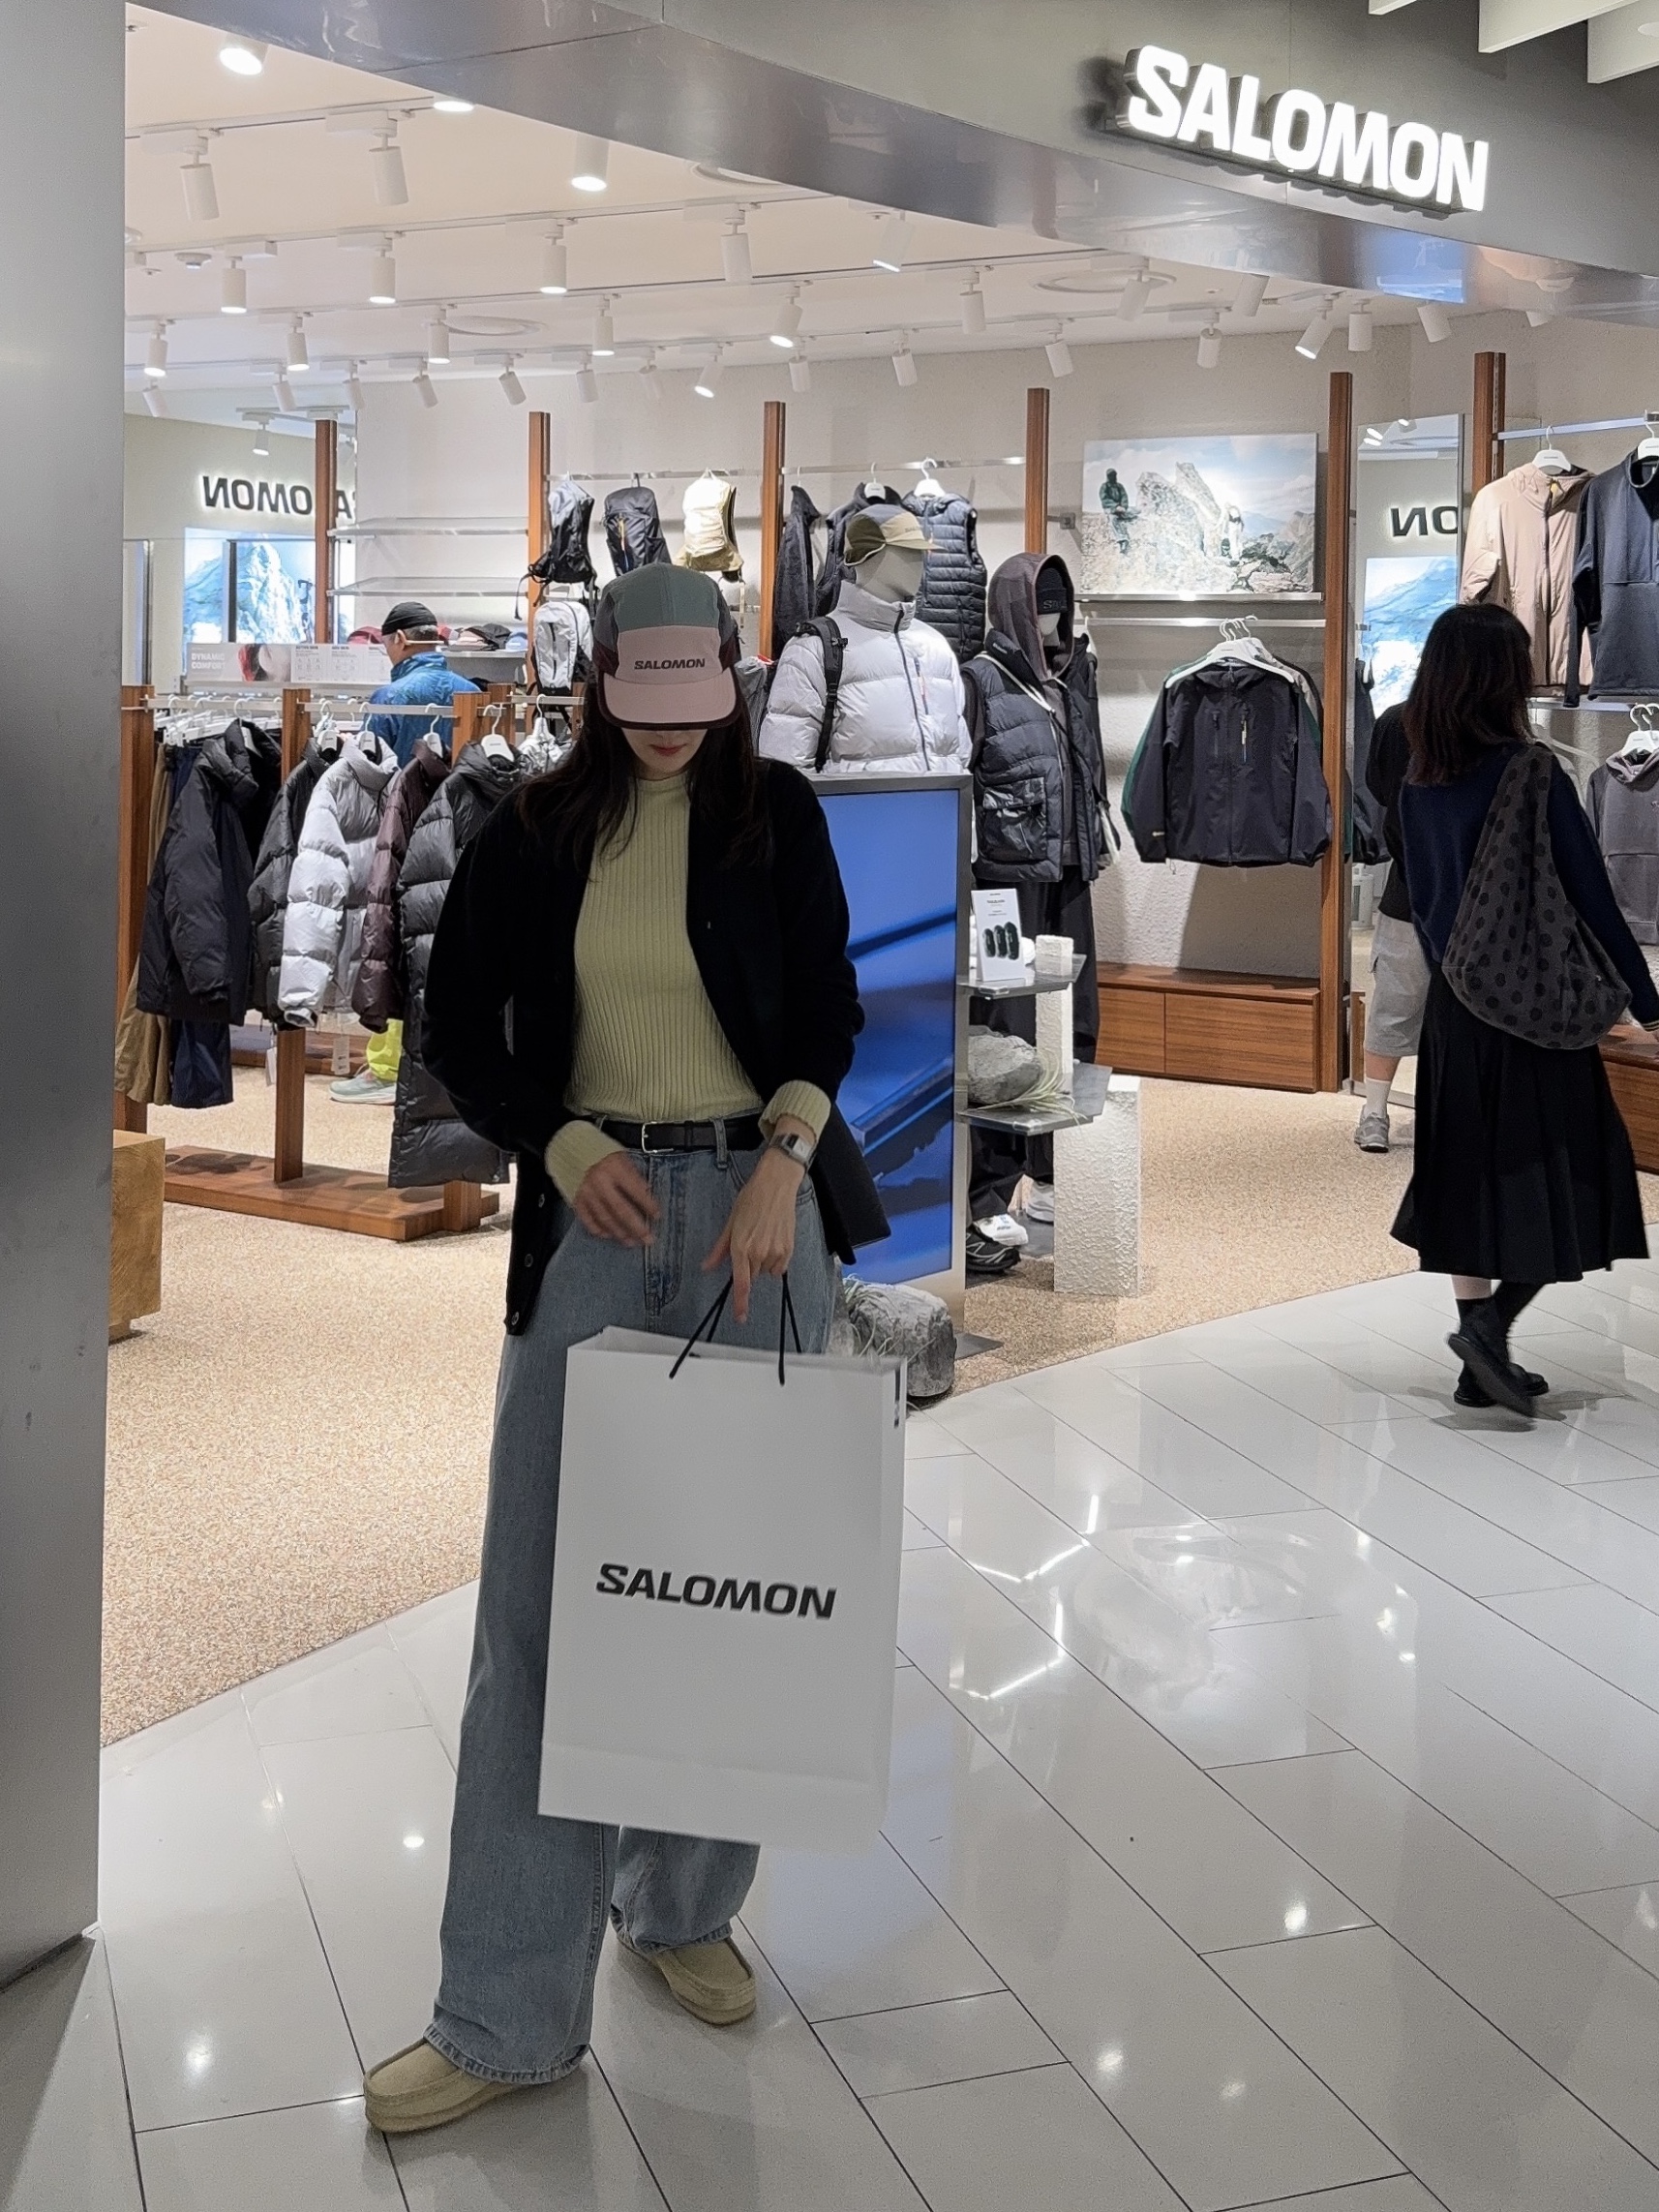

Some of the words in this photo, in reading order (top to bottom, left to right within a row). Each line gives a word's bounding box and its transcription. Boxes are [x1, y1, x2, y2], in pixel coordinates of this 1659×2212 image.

[1126, 45, 1489, 212] SALOMON
[634, 658, 706, 670] SALOMON
[595, 1562, 838, 1621] SALOMON
